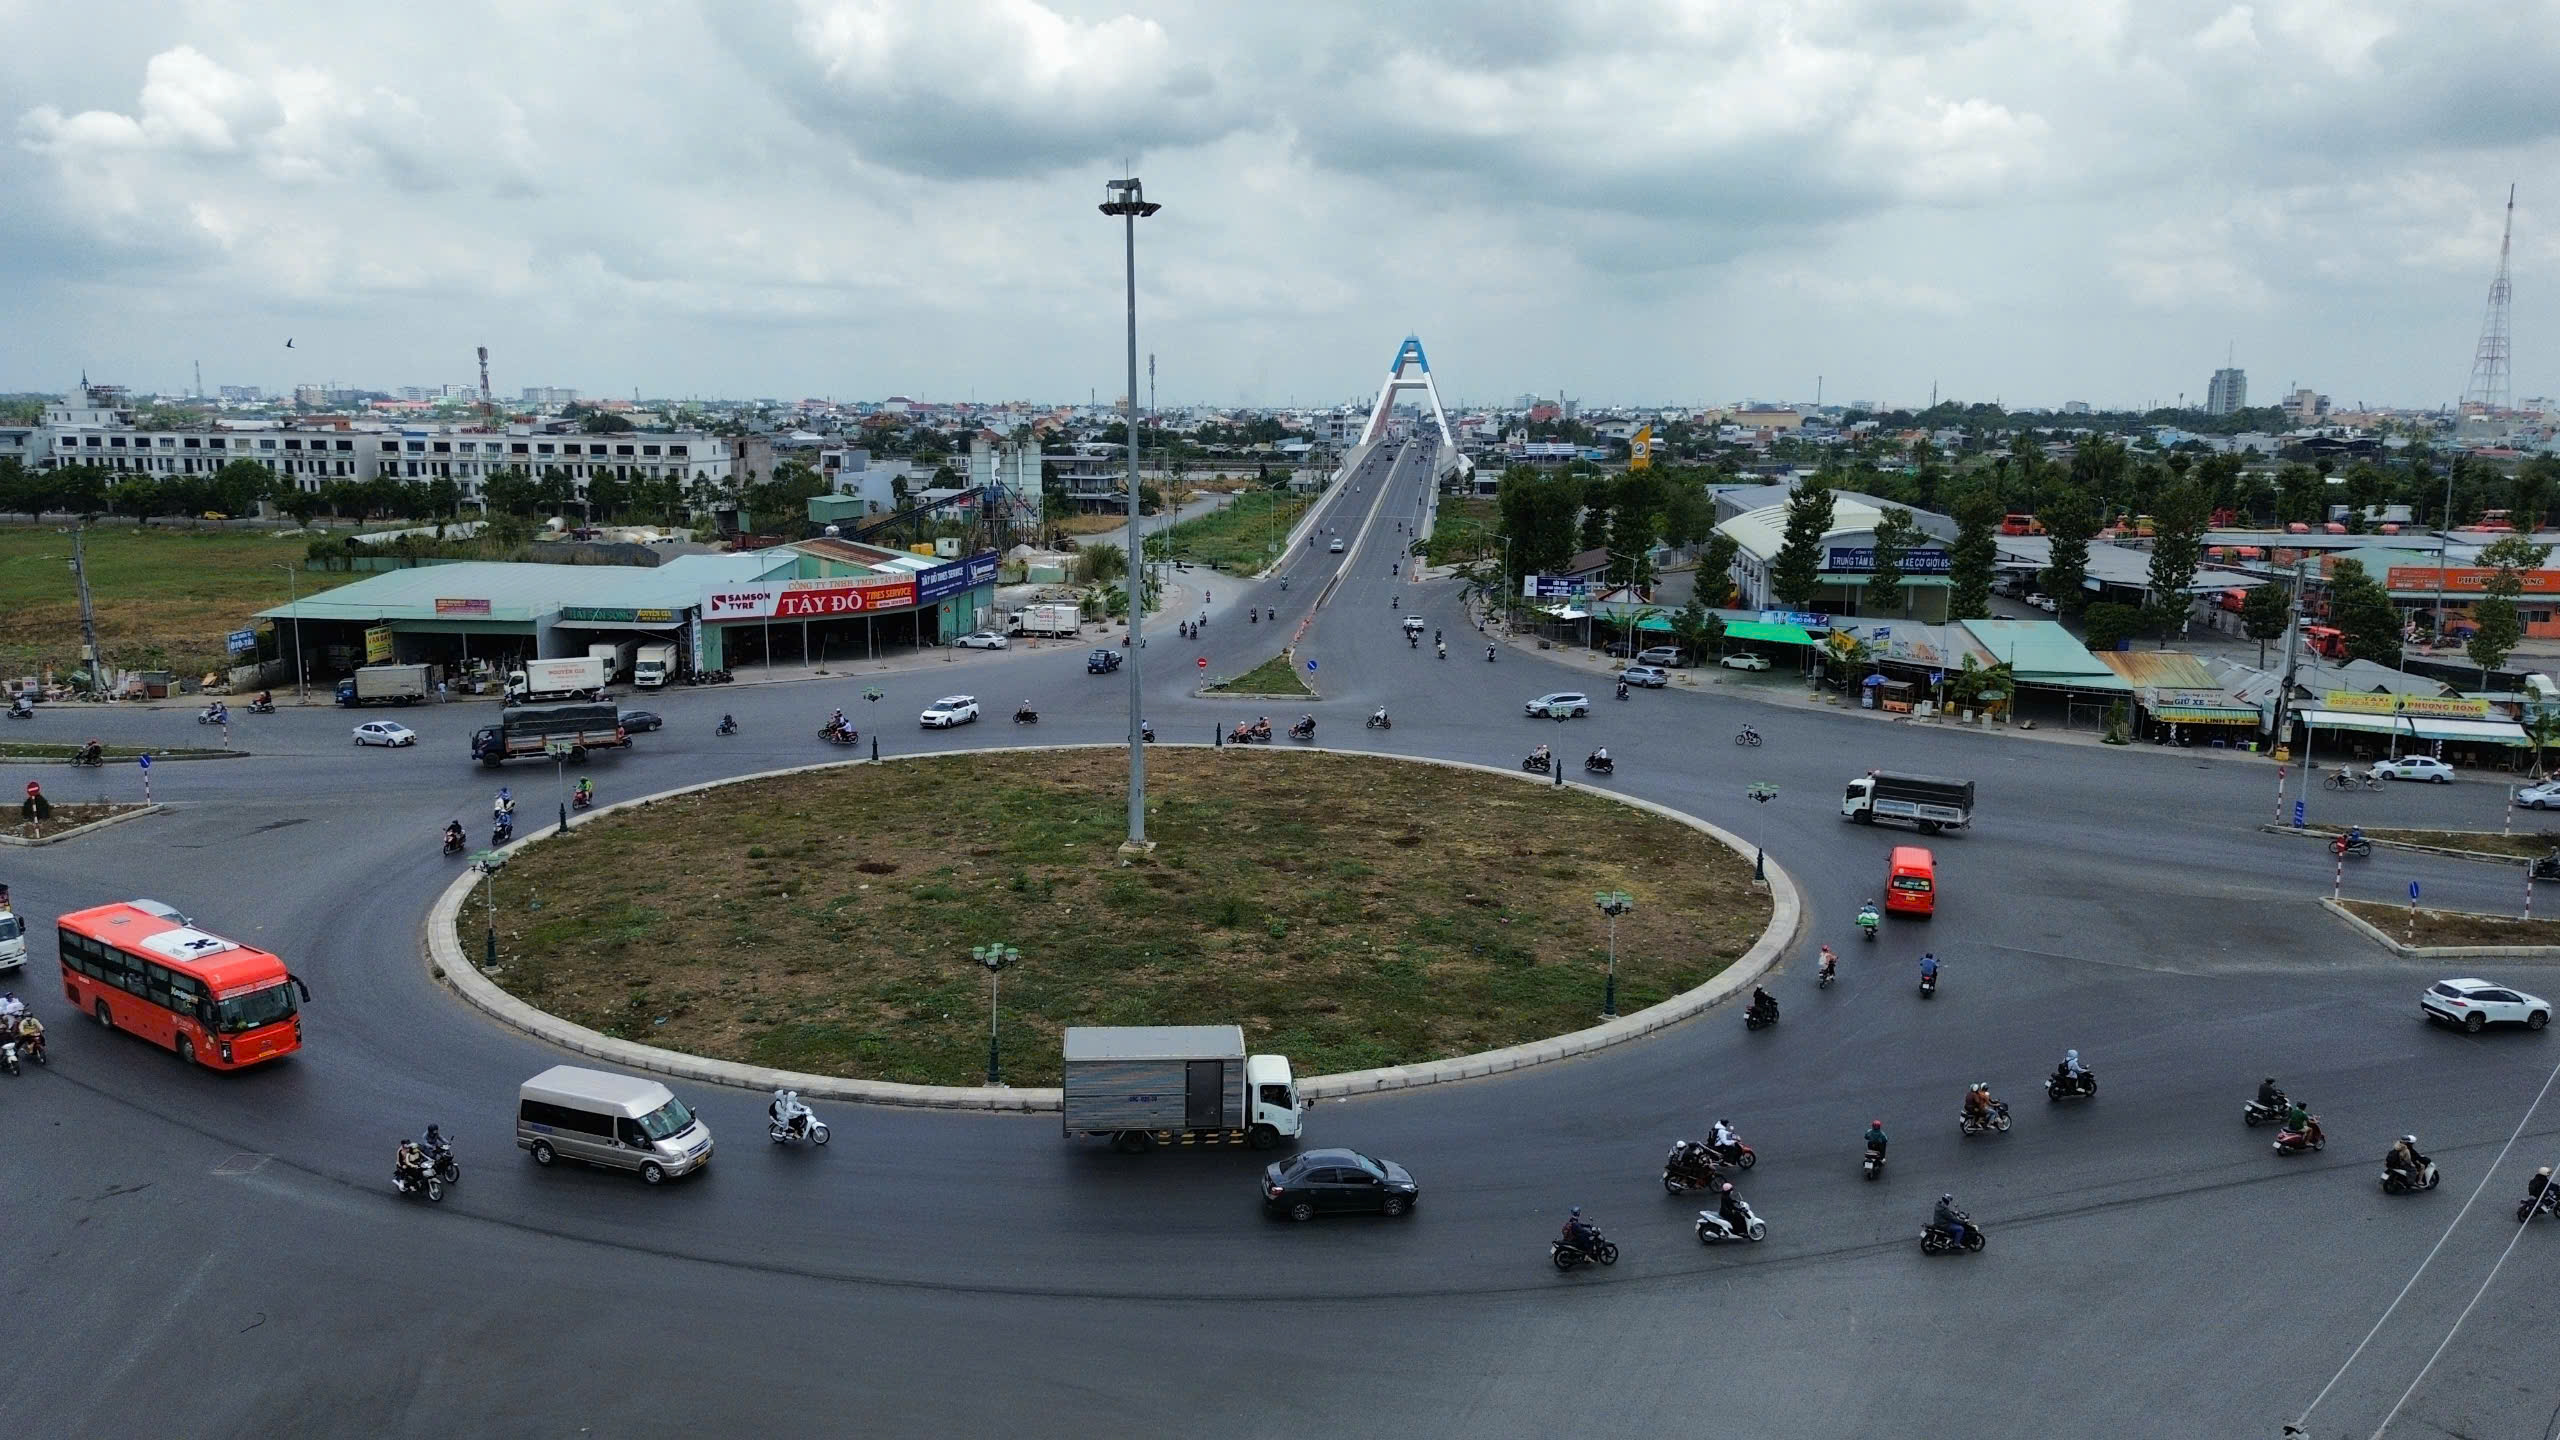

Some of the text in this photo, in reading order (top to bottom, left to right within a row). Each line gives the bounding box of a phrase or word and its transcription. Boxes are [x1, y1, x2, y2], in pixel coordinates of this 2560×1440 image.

[1832, 556, 1854, 566] TRUNG
[788, 581, 812, 591] CÔNG
[816, 580, 826, 589] TY
[829, 579, 854, 588] TNHH
[728, 592, 771, 602] SAMSON
[886, 587, 912, 598] SERVICE
[729, 602, 754, 610] TYRE
[782, 590, 863, 615] TÂY ĐÔ
